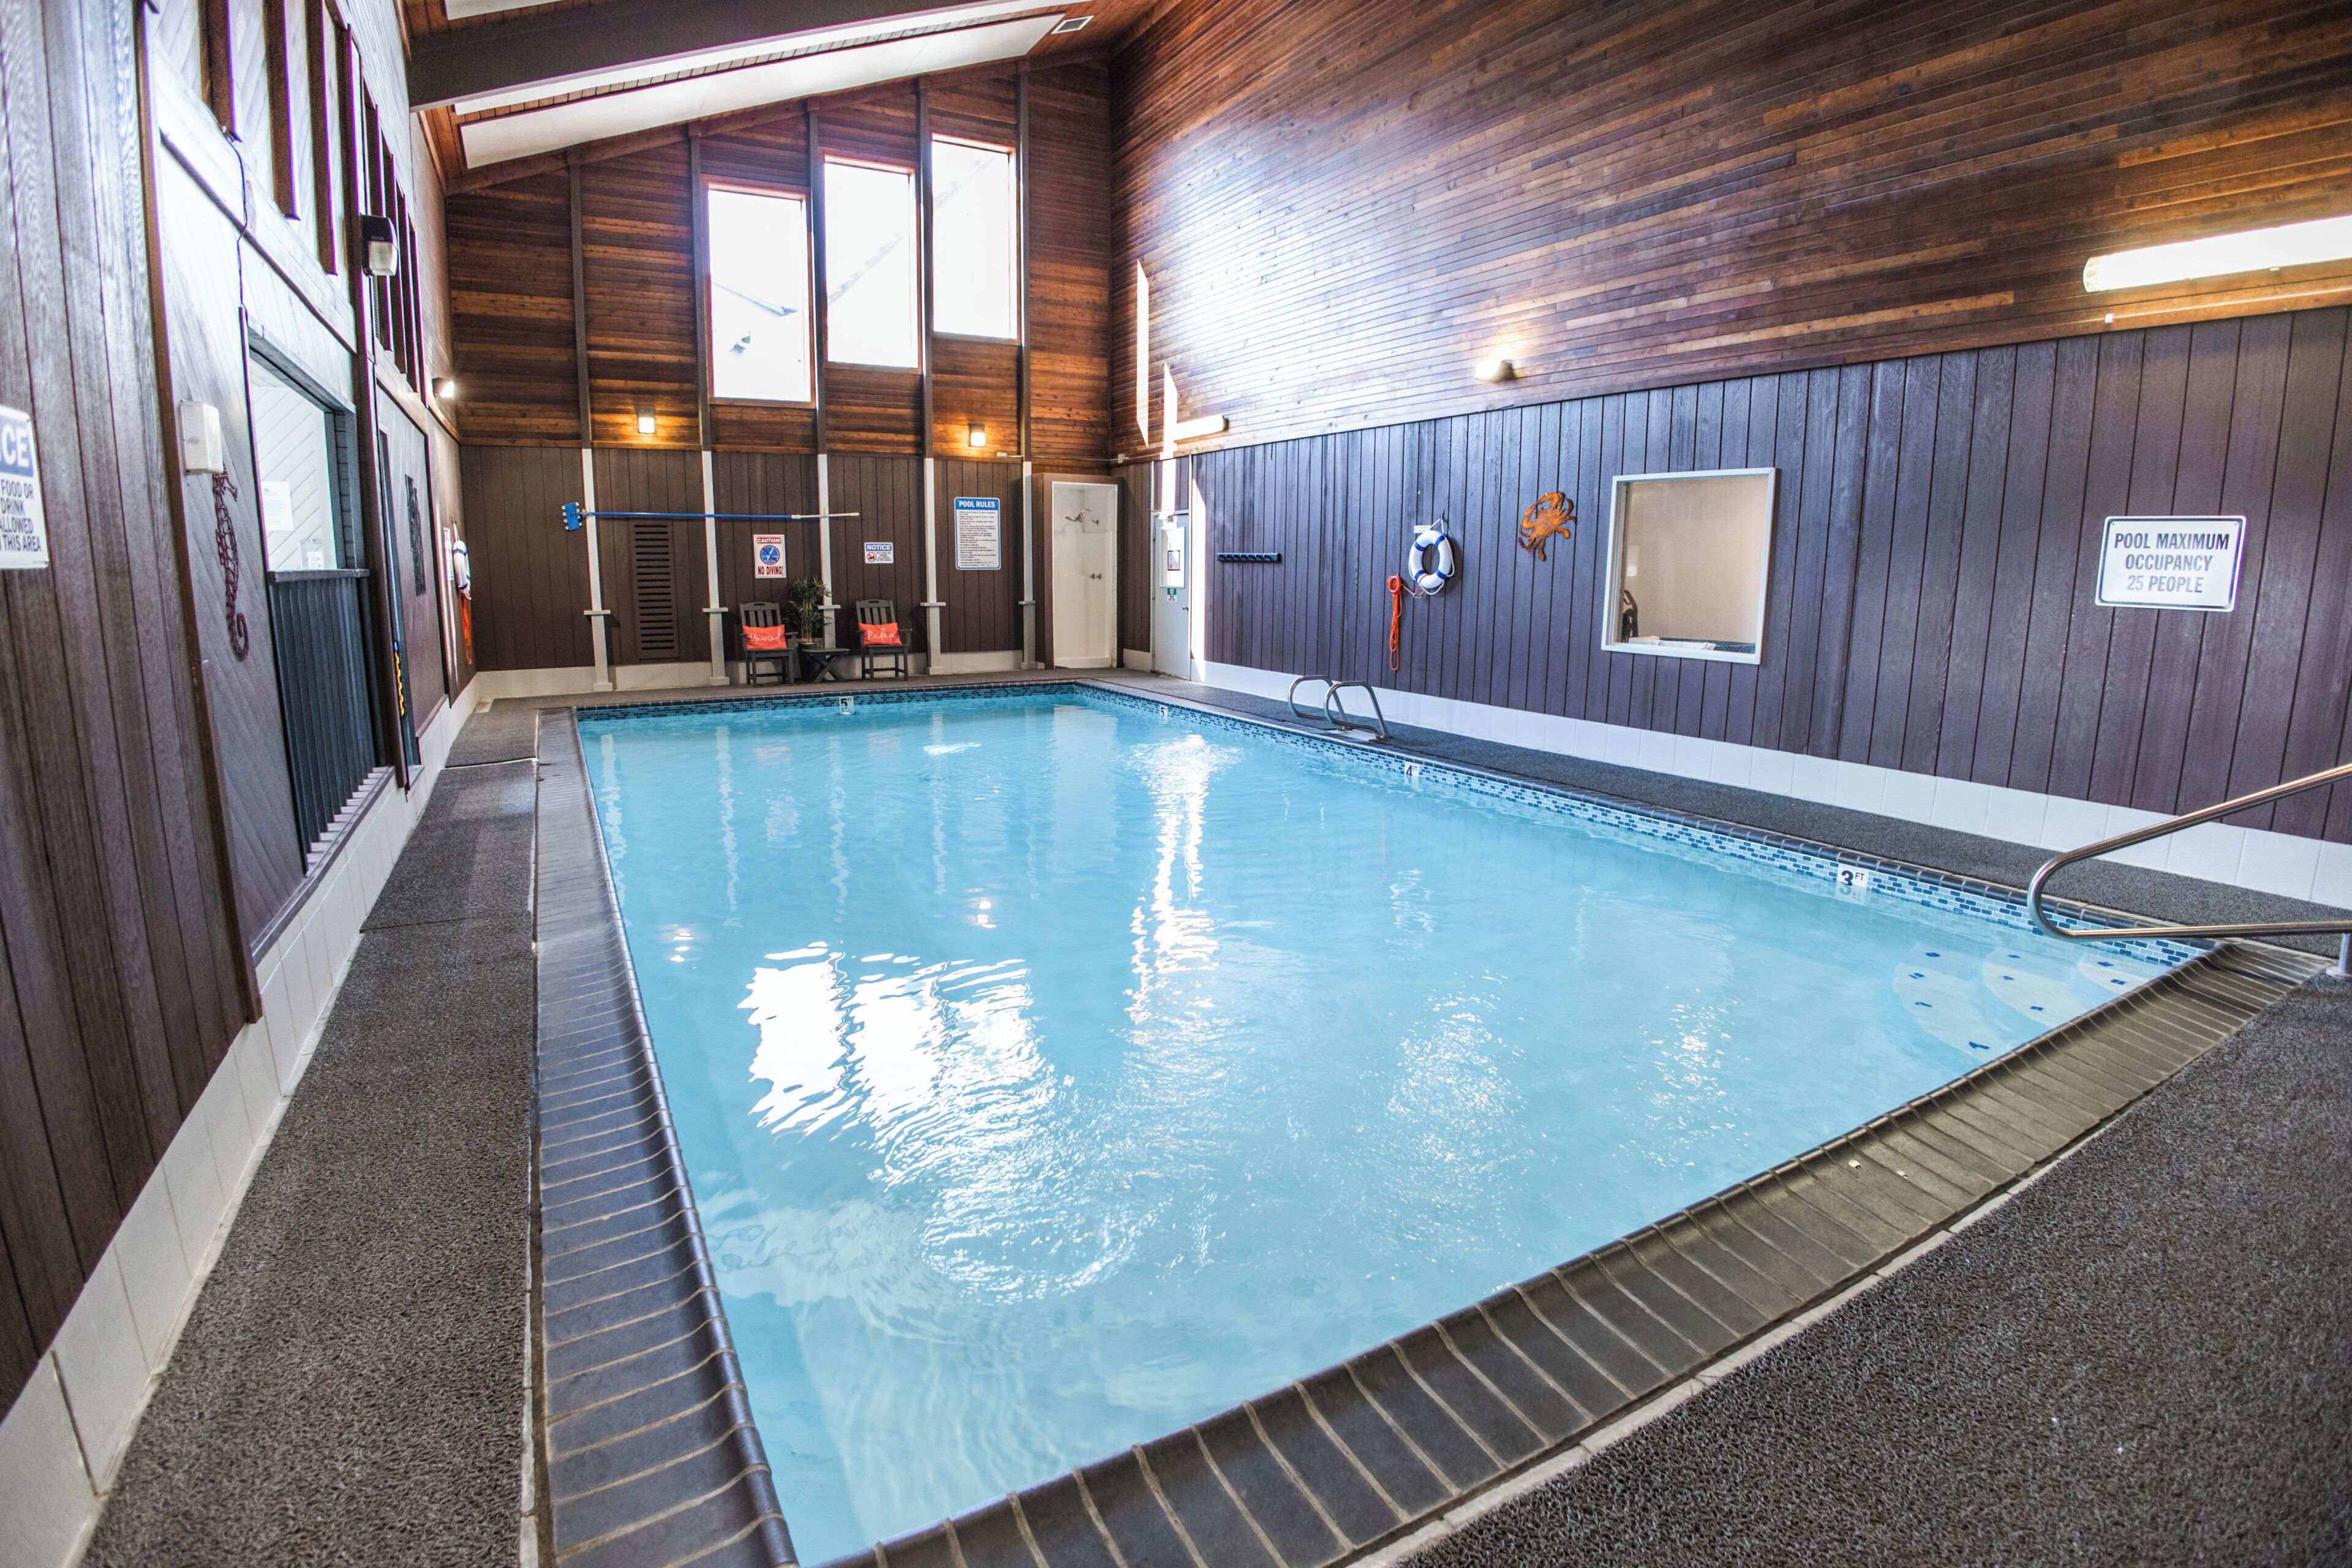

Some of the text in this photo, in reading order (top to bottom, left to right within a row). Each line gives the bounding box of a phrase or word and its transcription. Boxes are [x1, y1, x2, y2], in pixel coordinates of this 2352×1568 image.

[1, 479, 34, 500] FOOD OR
[1, 497, 25, 515] DRINK
[2, 534, 21, 551] THIS
[23, 535, 42, 551] AREA
[2114, 533, 2230, 550] POOL MAXIMUM
[758, 567, 783, 575] NO DIVING!
[2125, 554, 2213, 571] OCCUPANCY
[2127, 575, 2204, 593] 25 PEOPLE
[750, 628, 781, 644] Unwind
[867, 627, 895, 642] Relax
[1406, 765, 1412, 776] 4
[1841, 870, 1865, 886] 3 FT
